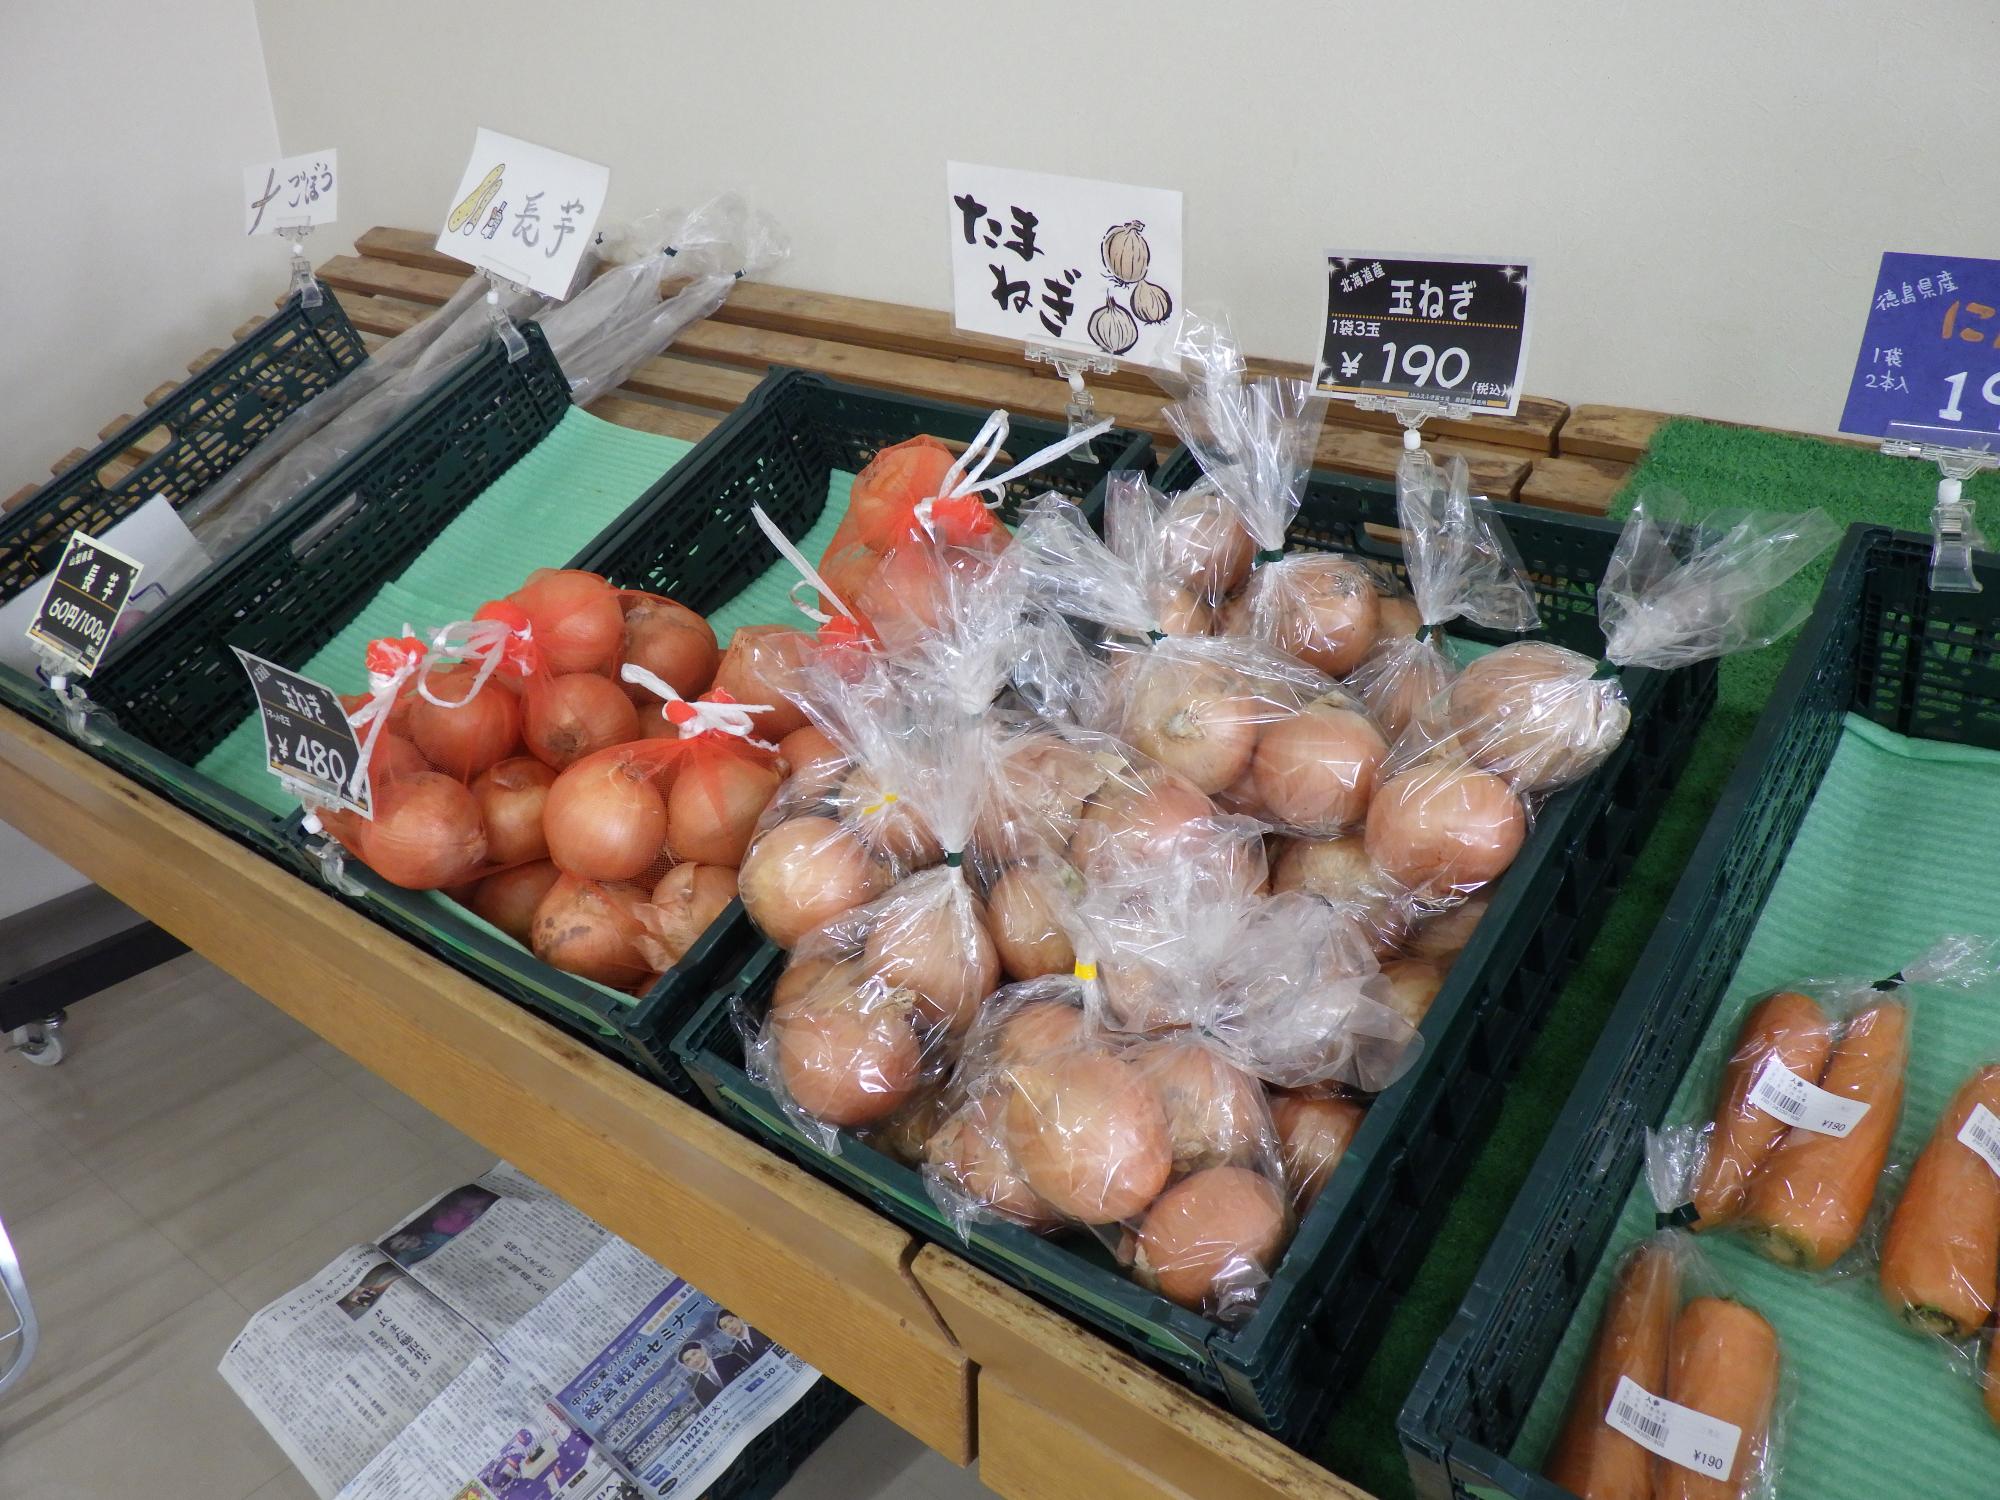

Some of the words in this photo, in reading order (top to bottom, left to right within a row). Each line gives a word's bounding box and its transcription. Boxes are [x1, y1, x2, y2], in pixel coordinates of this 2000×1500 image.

[288, 162, 333, 208] ごぼう
[512, 192, 585, 258] 長芋
[953, 194, 1045, 262] たま
[1340, 261, 1386, 293] 北海道産
[1875, 270, 1958, 311] 徳島県産
[988, 263, 1082, 337] ねぎ
[1388, 279, 1477, 321] 玉ねぎ
[1331, 319, 1381, 338] 1袋3玉
[1941, 300, 2000, 349] に
[1381, 341, 1470, 389] 190
[1471, 381, 1508, 397] (税込)
[1865, 370, 1909, 394] 2本入
[81, 563, 120, 601] 長芋
[48, 597, 106, 646] 60円/100g
[276, 680, 327, 725] 玉ねぎ
[295, 734, 346, 785] 480
[1821, 1119, 1847, 1132] ¥190
[581, 1301, 700, 1420] 経営戦略セミナー
[1693, 1449, 1723, 1470] ¥190
